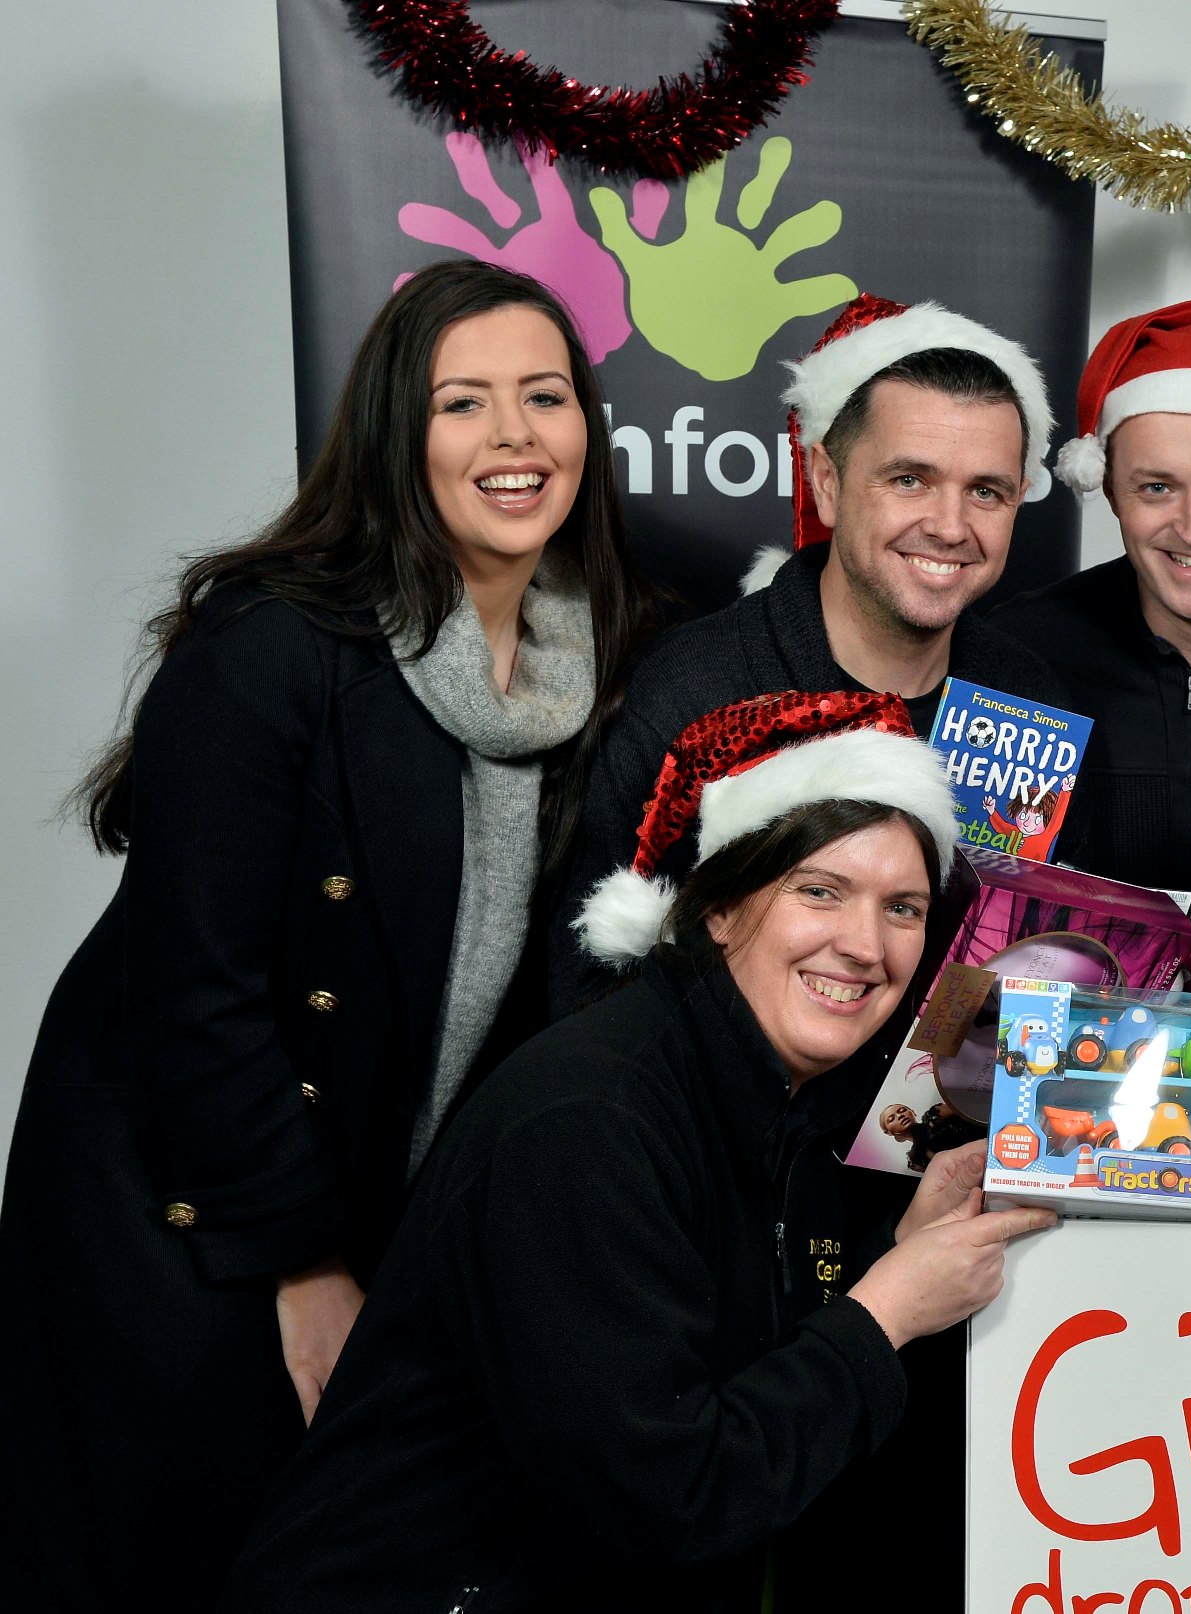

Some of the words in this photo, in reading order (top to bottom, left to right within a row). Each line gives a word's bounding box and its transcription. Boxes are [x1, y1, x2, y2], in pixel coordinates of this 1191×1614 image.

[972, 692, 1029, 719] Francesca
[1033, 711, 1069, 731] Simon
[945, 749, 1059, 807] HENRY
[959, 820, 1023, 856] otball
[942, 984, 973, 1034] HEAT
[1001, 1133, 1016, 1142] PULL
[1016, 1134, 1032, 1143] BACK
[1008, 1143, 1030, 1151] WATCH
[1001, 1150, 1018, 1159] THEM
[1018, 1151, 1030, 1160] GO!
[990, 1178, 1016, 1186] INCLUDES
[1016, 1180, 1041, 1188] TRACTOR
[1045, 1182, 1065, 1190] DIGGER
